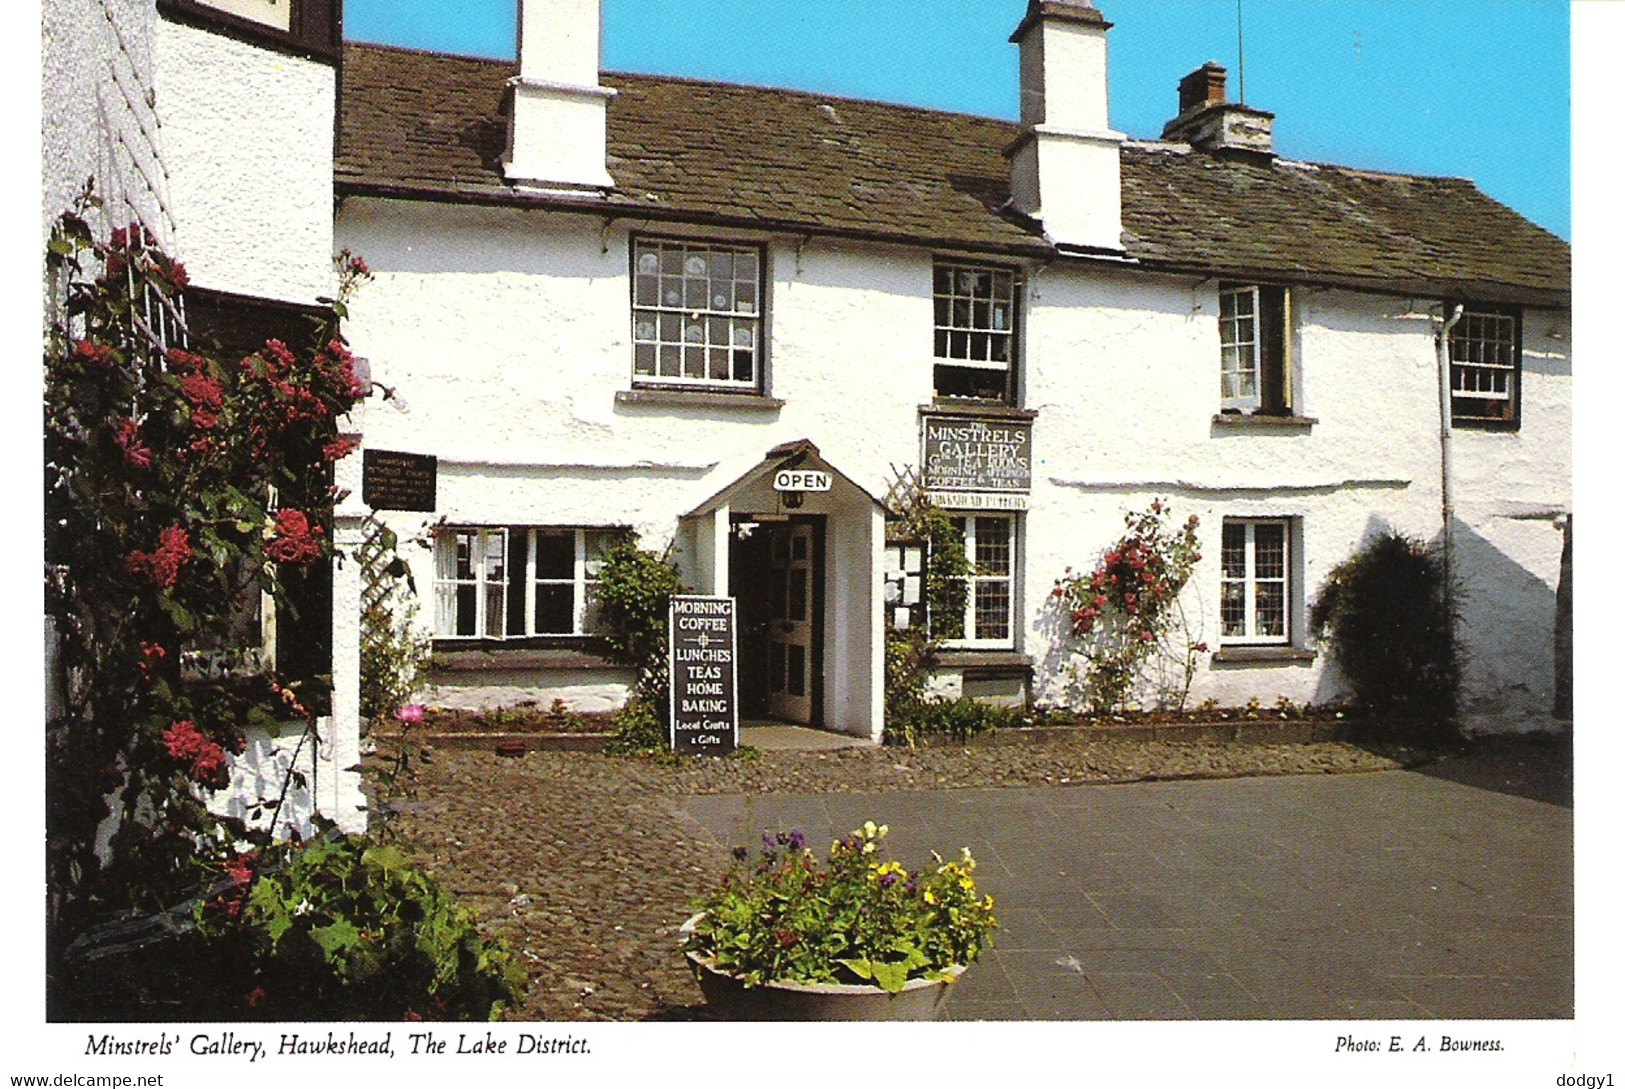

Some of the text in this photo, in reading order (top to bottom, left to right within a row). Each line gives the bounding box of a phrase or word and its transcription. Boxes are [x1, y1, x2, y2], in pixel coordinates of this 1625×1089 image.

[928, 426, 1026, 444] MINSTRELS
[939, 441, 1020, 459] GALLERY
[927, 466, 978, 476] MORNING
[778, 473, 827, 488] OPEN
[929, 476, 976, 487] COFFEE
[990, 478, 1021, 488] TEAS
[674, 600, 731, 615] MORNING
[679, 617, 727, 631] COFFEE
[676, 648, 731, 662] LUNCHES
[687, 666, 721, 679] TEAS
[687, 682, 723, 695] HOME
[681, 699, 727, 713] BAKING
[675, 719, 730, 730] Local Crafts
[697, 734, 720, 744] Gifts
